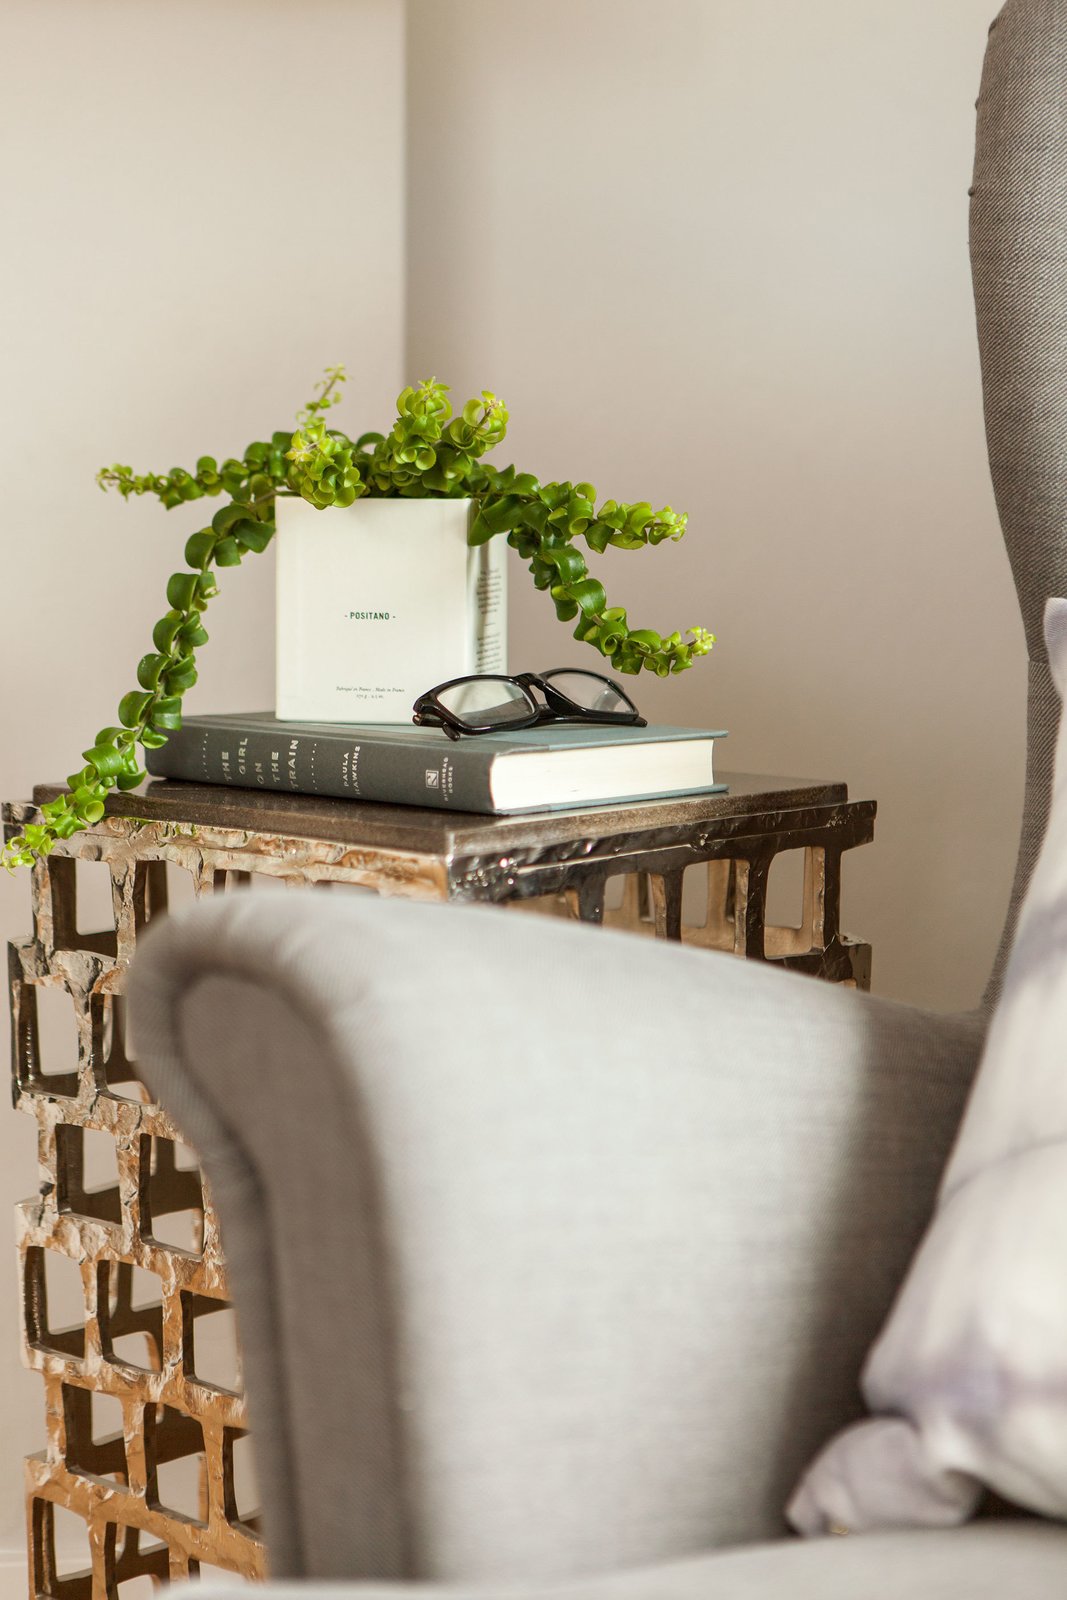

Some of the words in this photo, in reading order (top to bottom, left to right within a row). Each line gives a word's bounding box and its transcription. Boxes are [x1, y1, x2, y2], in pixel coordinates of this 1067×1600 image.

[221, 751, 232, 782] THE
[238, 738, 248, 775] GIRL
[271, 751, 281, 783] THE
[287, 739, 299, 789] TRAIN
[342, 752, 350, 787] PAULA
[254, 762, 265, 785] ON
